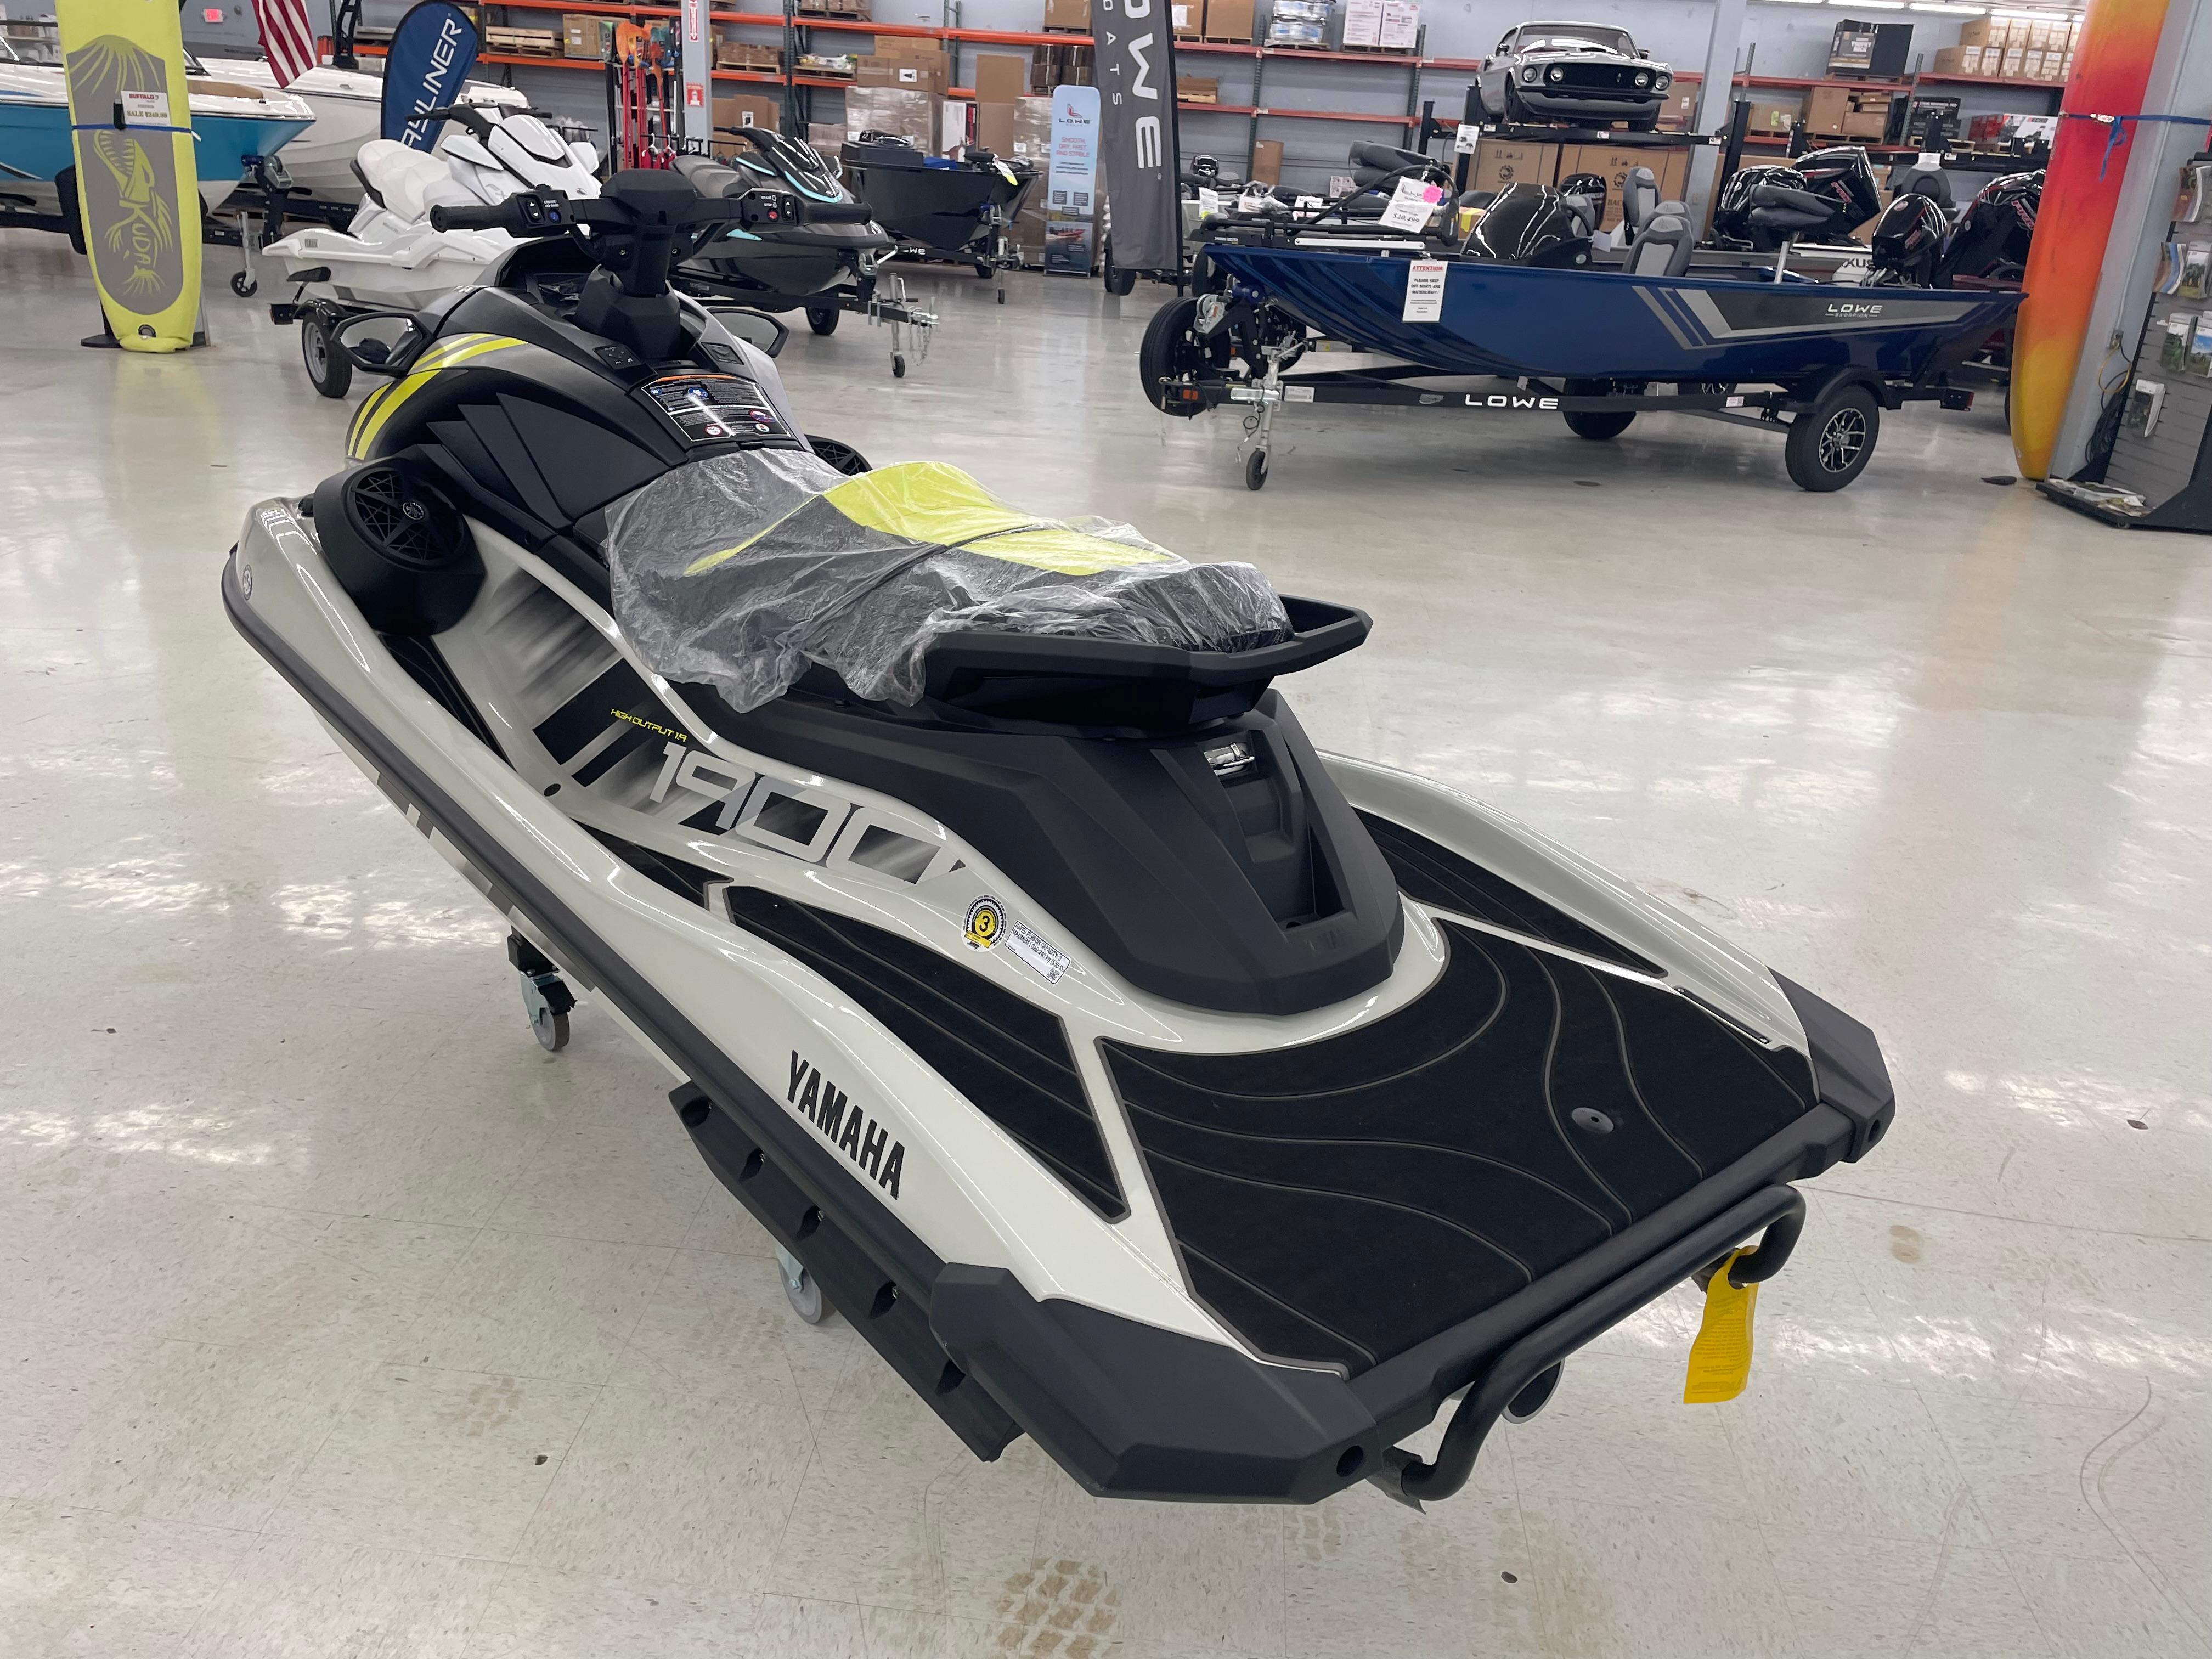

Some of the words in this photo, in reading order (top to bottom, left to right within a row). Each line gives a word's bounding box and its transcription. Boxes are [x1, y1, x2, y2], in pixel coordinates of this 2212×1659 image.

[401, 18, 462, 147] AYLINER
[1827, 303, 1883, 313] LOWE
[1465, 394, 1559, 410] LOWE
[611, 708, 632, 721] HIGH
[631, 716, 675, 737] OUTPUT
[650, 741, 957, 891] 1900
[979, 915, 990, 932] 3
[1015, 922, 1027, 934] RATED
[1026, 931, 1041, 945] PERSON
[1012, 929, 1030, 945] MAXIMUM
[1045, 955, 1051, 963] kg
[1050, 959, 1060, 968] (530
[787, 1049, 905, 1200] YAMAHA
